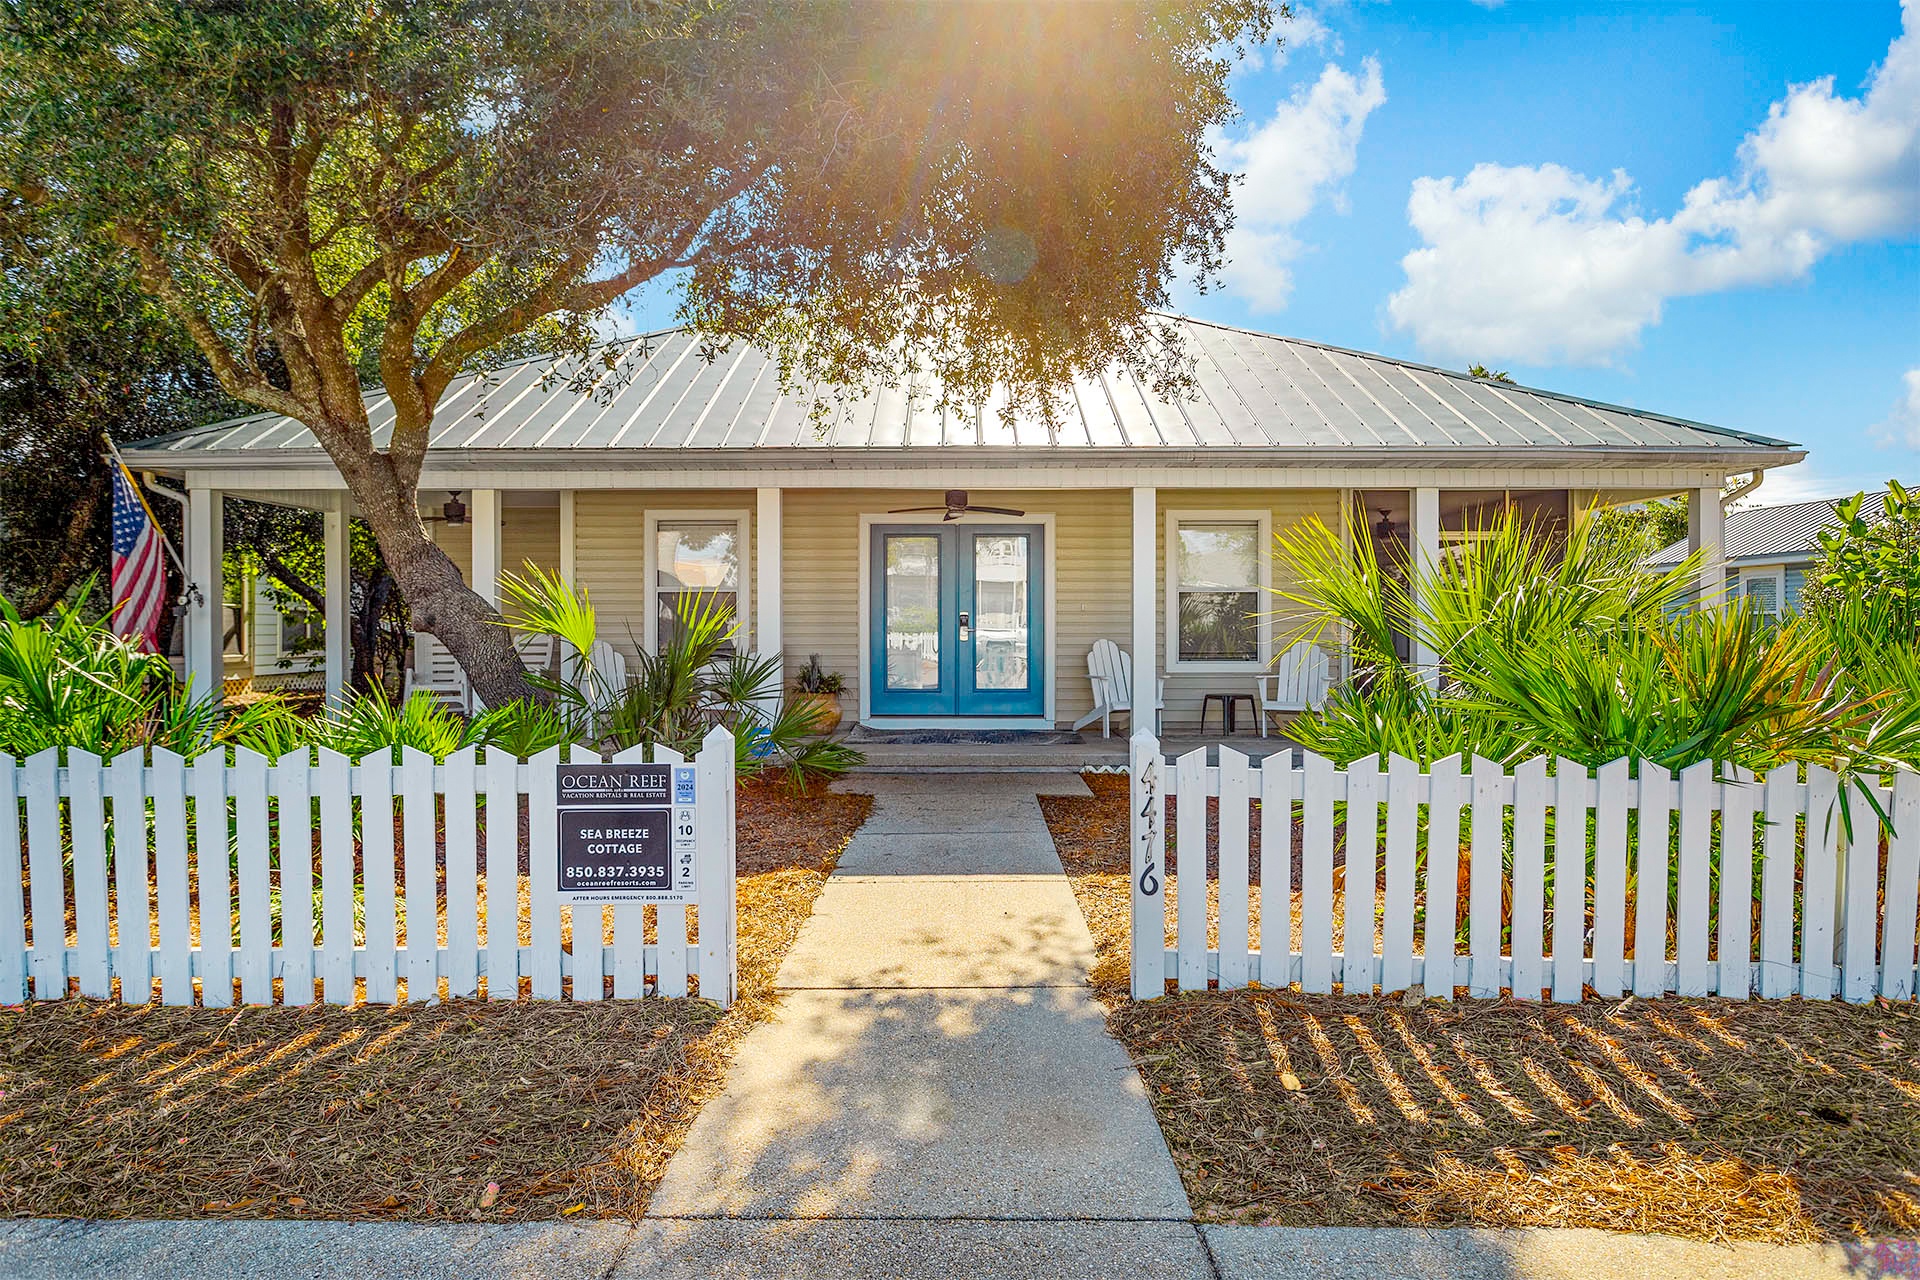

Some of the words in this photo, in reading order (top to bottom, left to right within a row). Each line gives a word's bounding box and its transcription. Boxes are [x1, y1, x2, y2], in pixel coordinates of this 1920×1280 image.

[562, 775, 622, 788] OCEAN
[629, 775, 667, 788] REEF
[677, 783, 693, 791] 2024
[678, 825, 693, 835] 10
[1139, 757, 1159, 896] 4476
[580, 829, 602, 839] SEA
[606, 828, 649, 838] BREEZE
[587, 844, 642, 854] COTTAGE
[566, 866, 664, 878] 850.837.3935
[682, 867, 690, 877] 2
